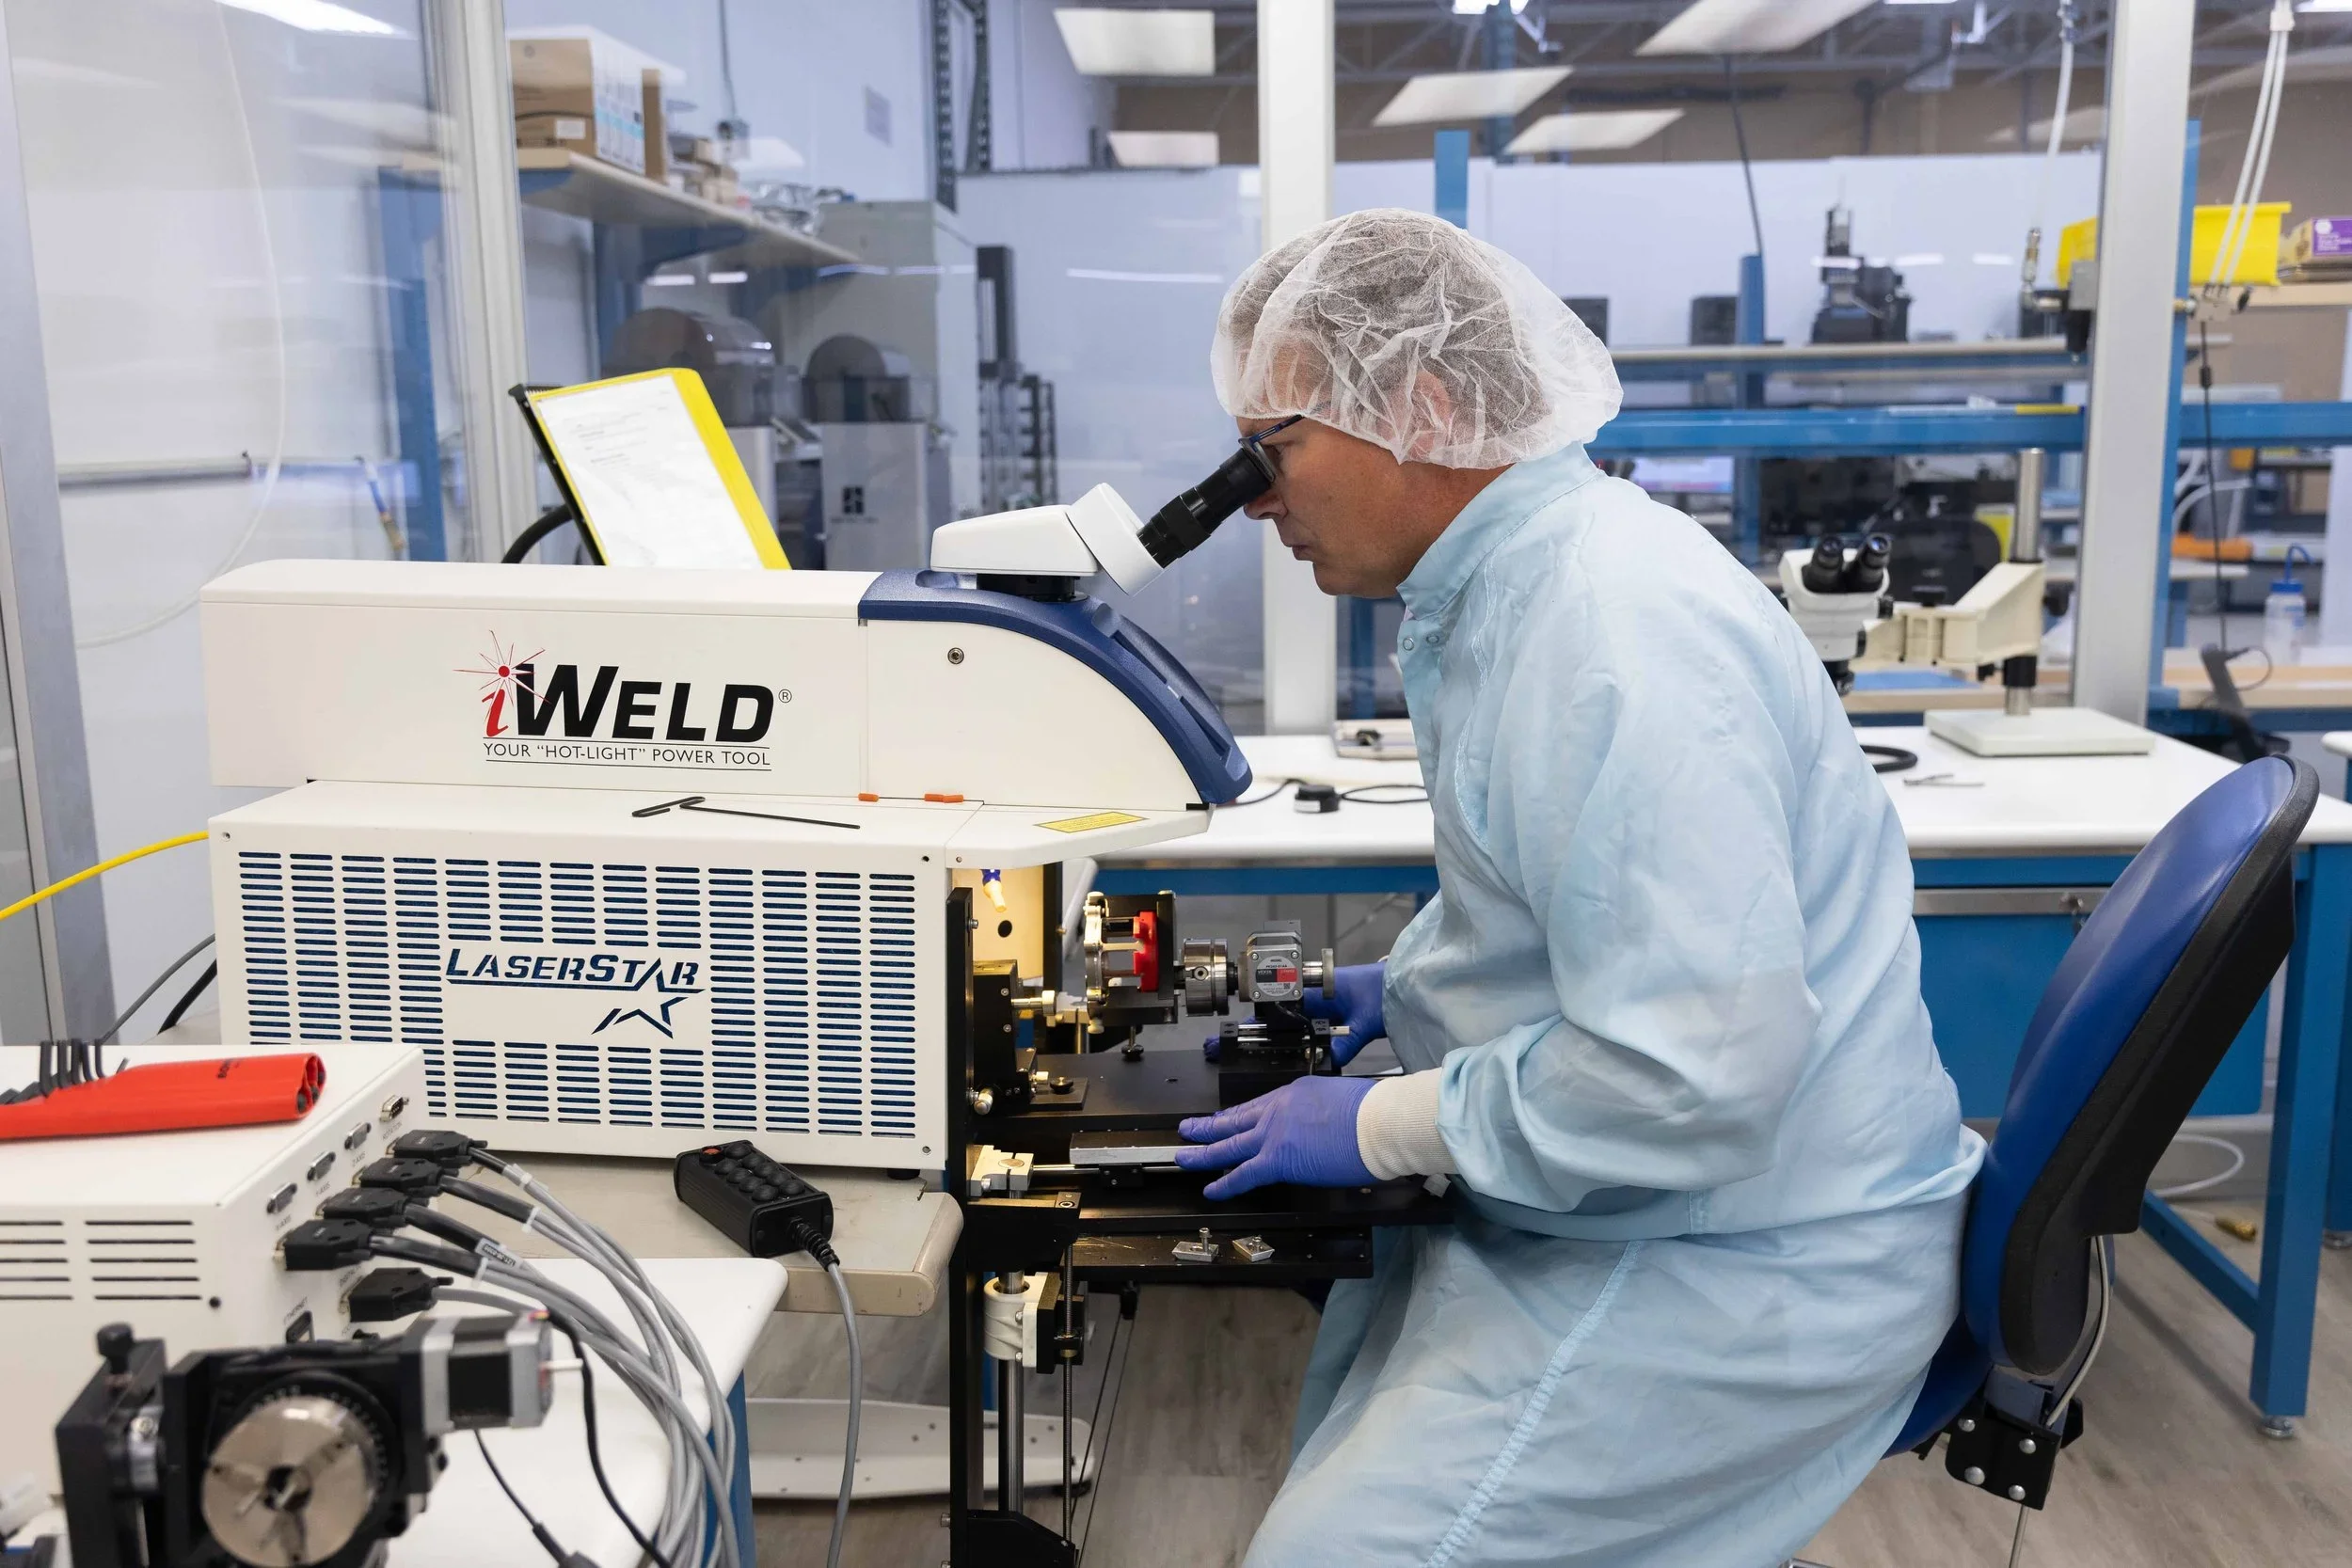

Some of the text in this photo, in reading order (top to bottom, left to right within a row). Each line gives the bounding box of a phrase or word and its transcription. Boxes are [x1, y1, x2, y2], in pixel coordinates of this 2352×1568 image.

[483, 742, 532, 758] YOUR
[652, 748, 715, 764] POWER
[721, 751, 771, 766] TOOL
